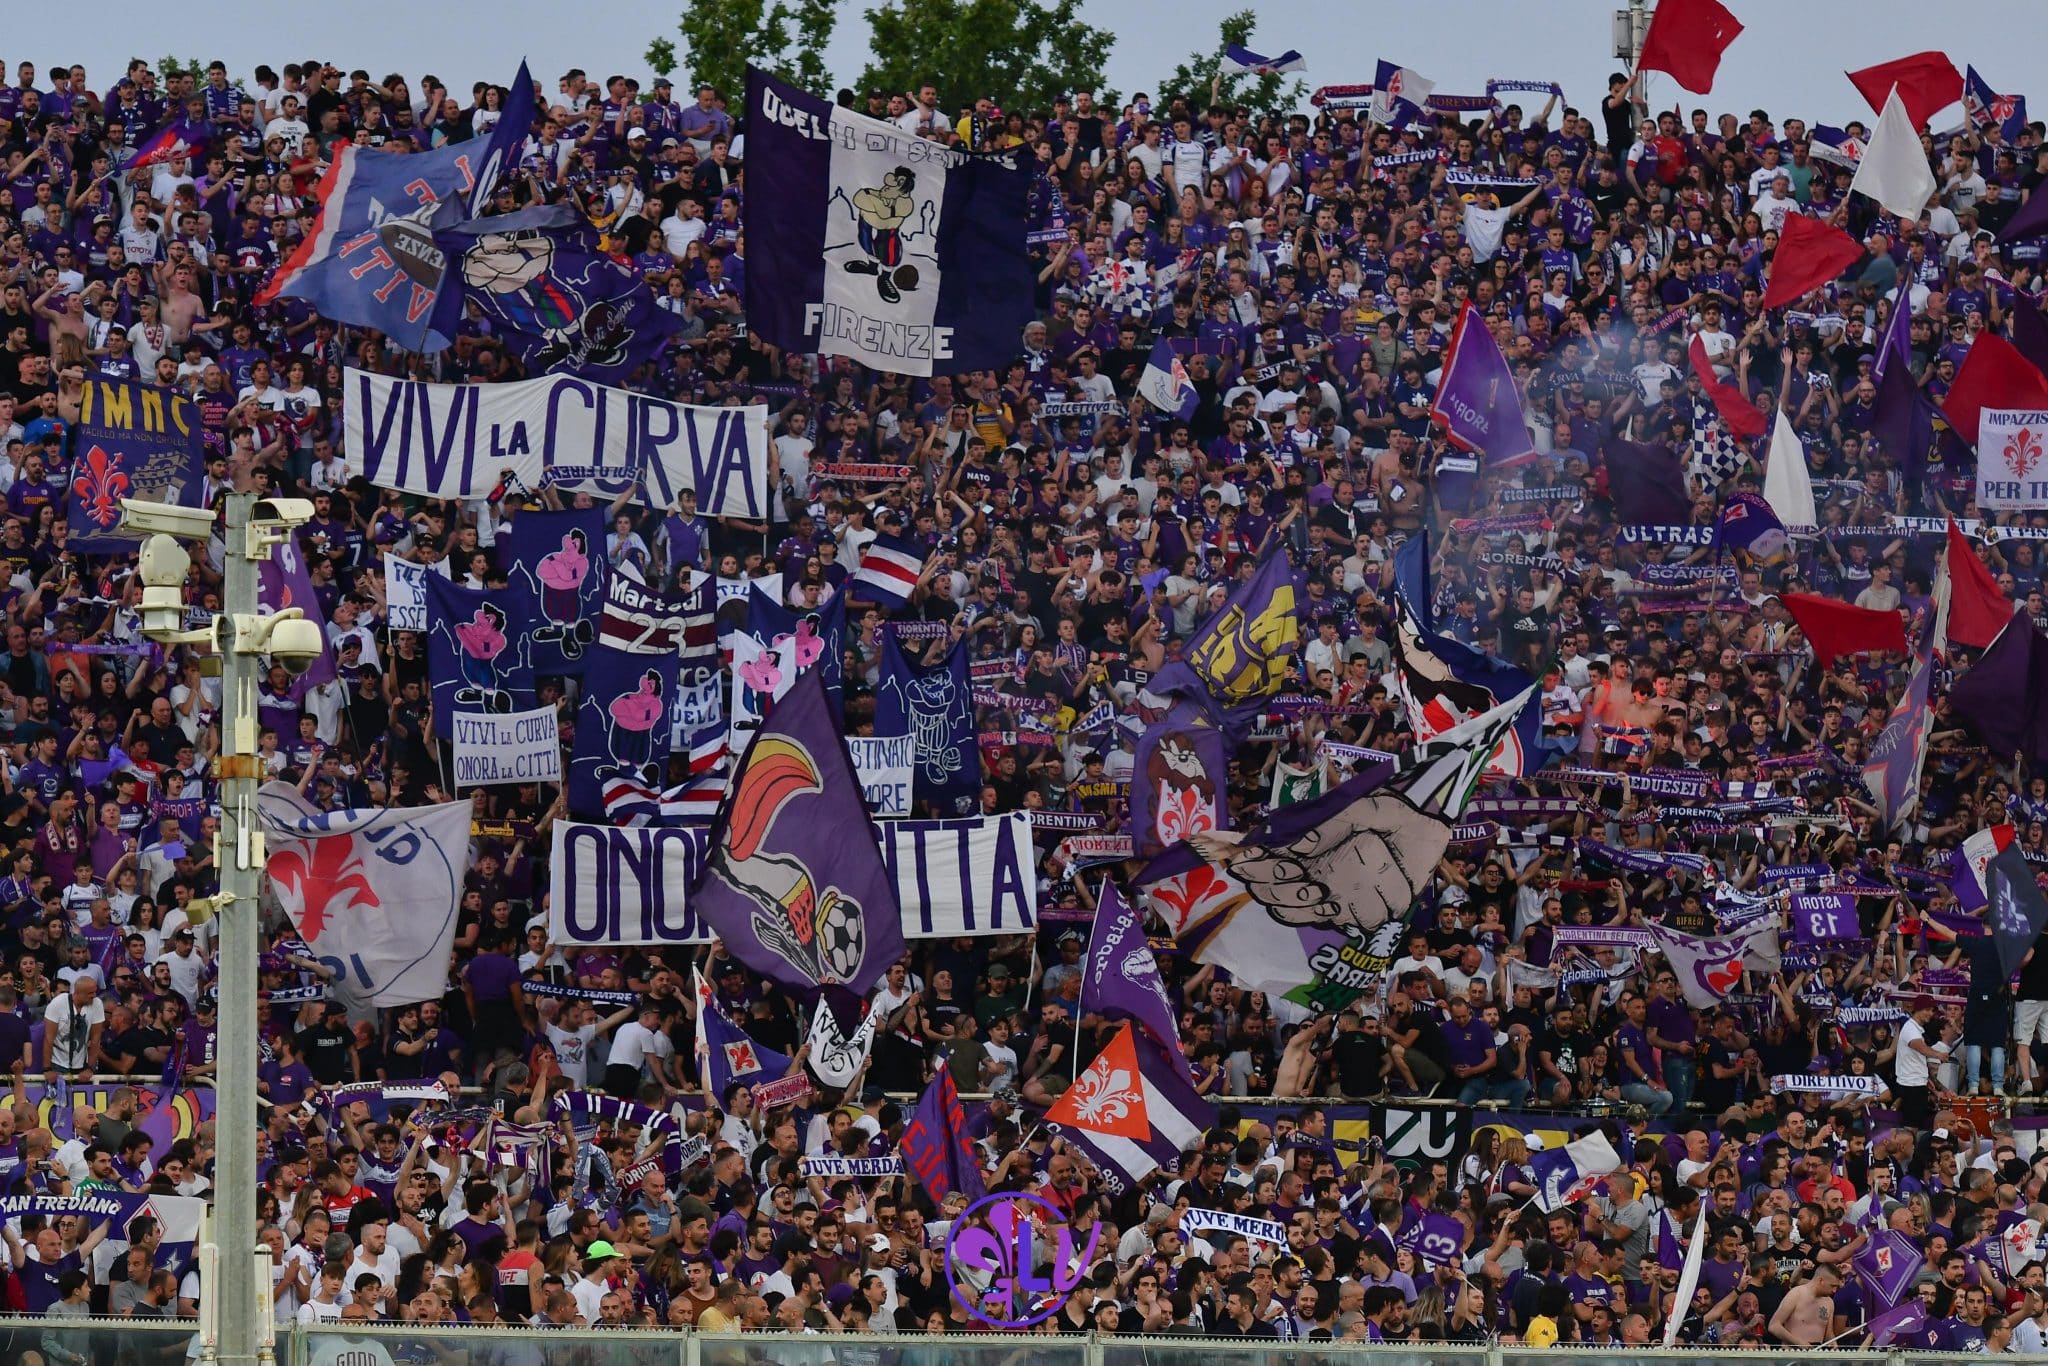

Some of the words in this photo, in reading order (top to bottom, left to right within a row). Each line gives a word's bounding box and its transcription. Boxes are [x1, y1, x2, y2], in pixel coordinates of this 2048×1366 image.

[803, 303, 954, 360] FIRENZE
[1045, 402, 1110, 415] COLLETTIVO
[358, 375, 479, 496] VIVI
[489, 420, 530, 458] LA
[542, 377, 760, 519] CURVA
[829, 463, 895, 479] FIORENTINA
[966, 472, 991, 481] NATO
[1984, 480, 2021, 500] PER
[1622, 525, 1714, 545] ULTRAS
[350, 542, 362, 566] 7
[626, 611, 688, 659] 23
[1513, 622, 1539, 632] adidas
[457, 719, 497, 745] VIVI
[501, 732, 513, 745] LA
[515, 713, 556, 744] CURVA
[457, 757, 499, 781] ONORA
[502, 767, 514, 779] LA
[1764, 866, 1816, 879] FIORENTINA
[1557, 930, 1607, 941] FIORENTINA
[1610, 931, 1624, 941] SEI
[522, 981, 563, 995] QUELLI
[582, 989, 633, 1003] SEMPRE
[1792, 1074, 1867, 1090] DIRETTIVO
[802, 1159, 847, 1177] JUVE
[847, 1159, 906, 1177] MERDA
[34, 1195, 122, 1217] FREDIANO
[499, 1271, 518, 1284] UFC
